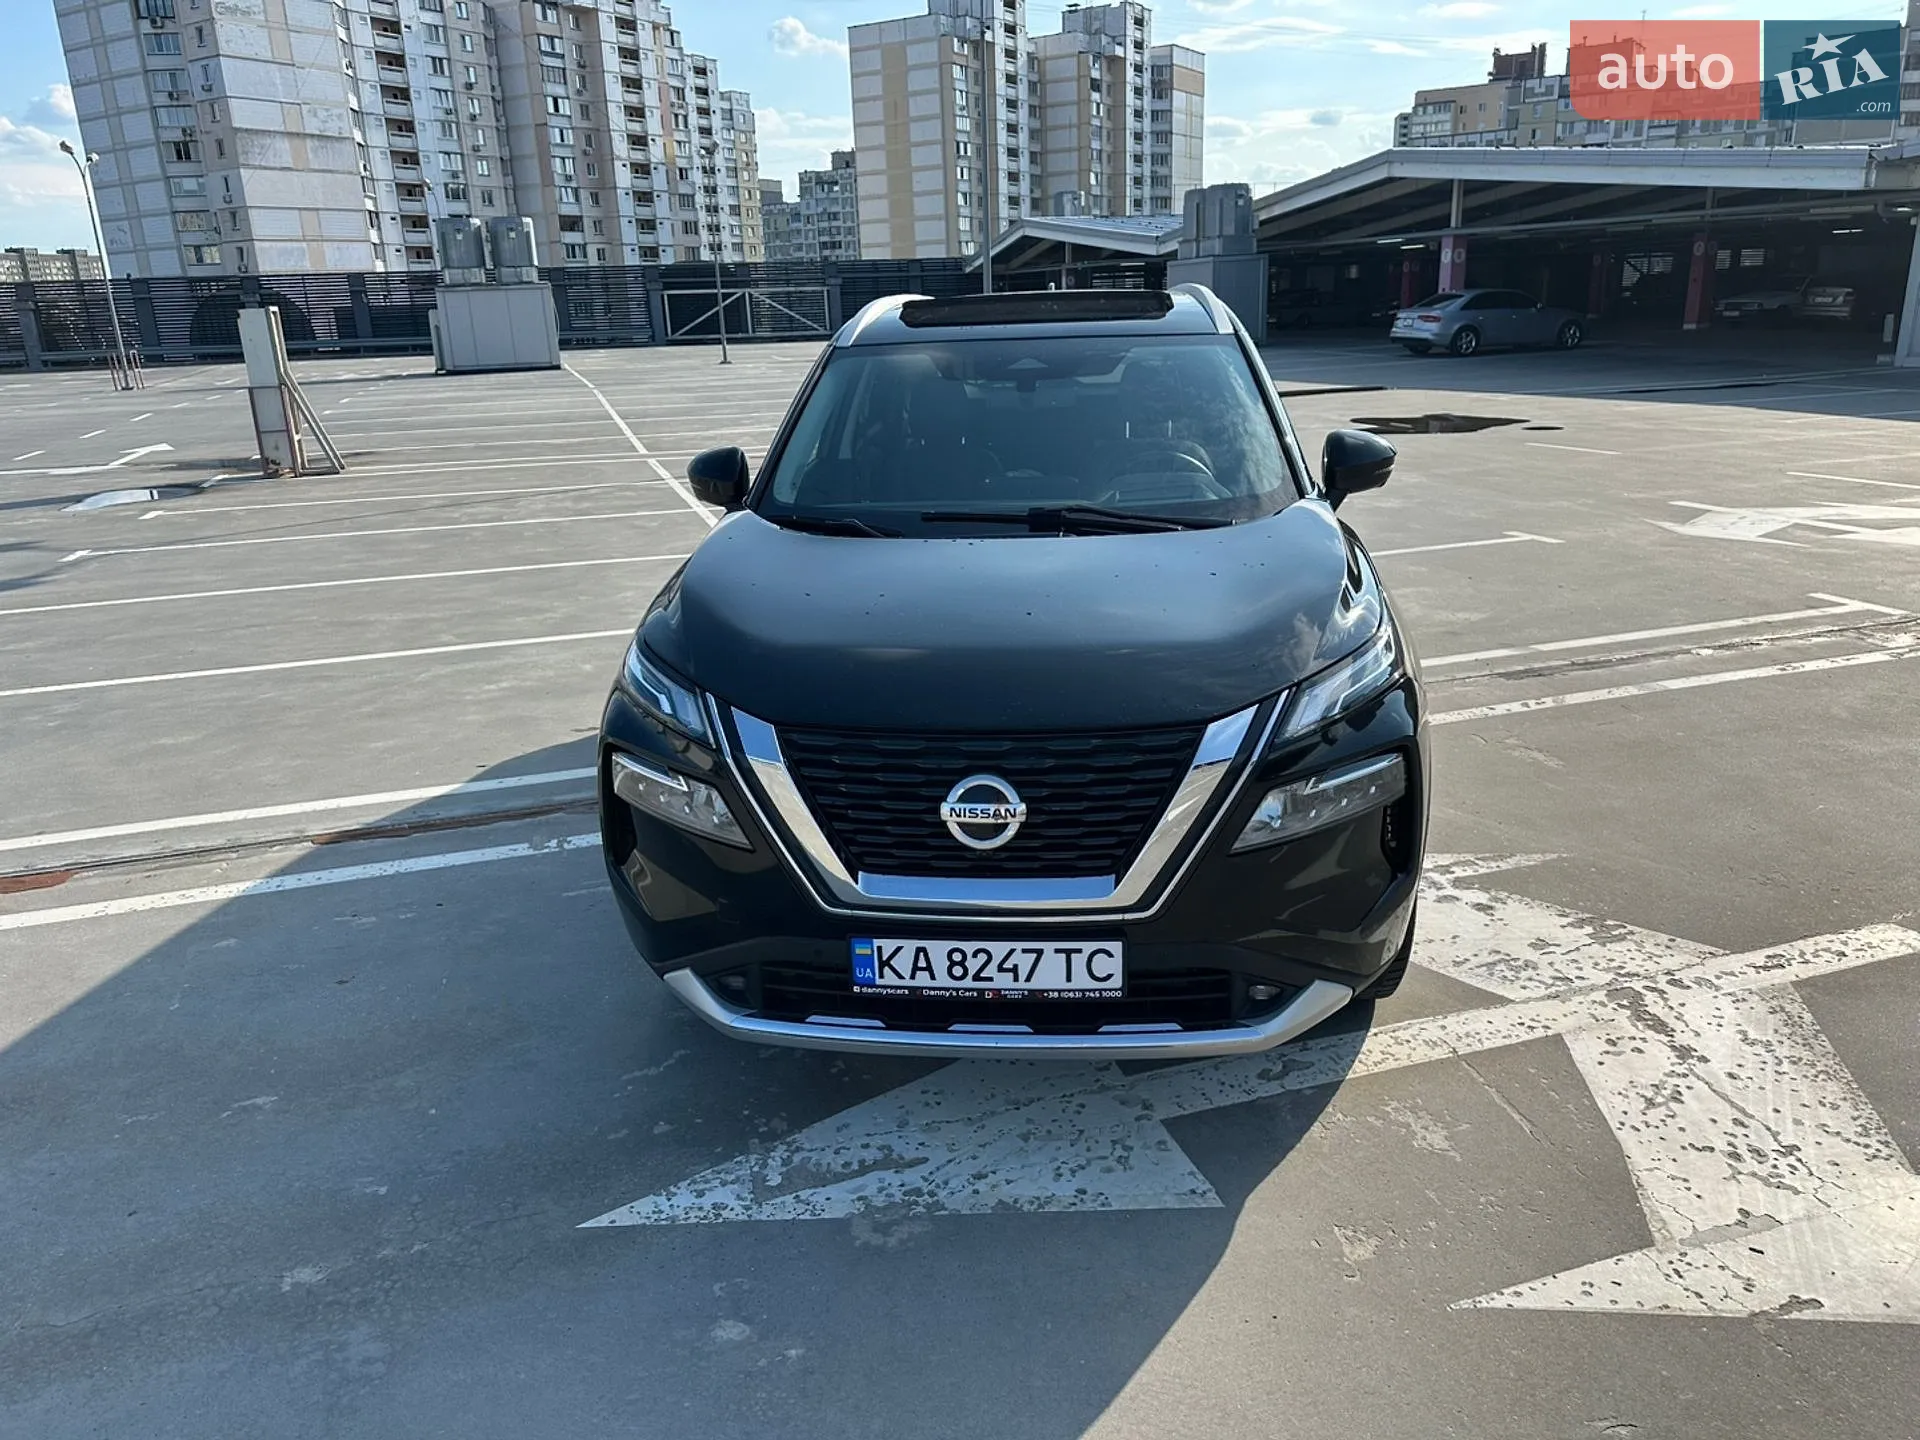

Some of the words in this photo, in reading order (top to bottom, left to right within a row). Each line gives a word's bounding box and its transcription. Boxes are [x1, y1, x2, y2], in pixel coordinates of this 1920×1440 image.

[949, 807, 1017, 819] NISSAN
[876, 945, 936, 981] KA
[946, 947, 1045, 983] 8247
[1053, 947, 1115, 983] TC
[855, 968, 874, 979] UA
[922, 988, 957, 997] Danny's
[958, 989, 978, 997] Cars
